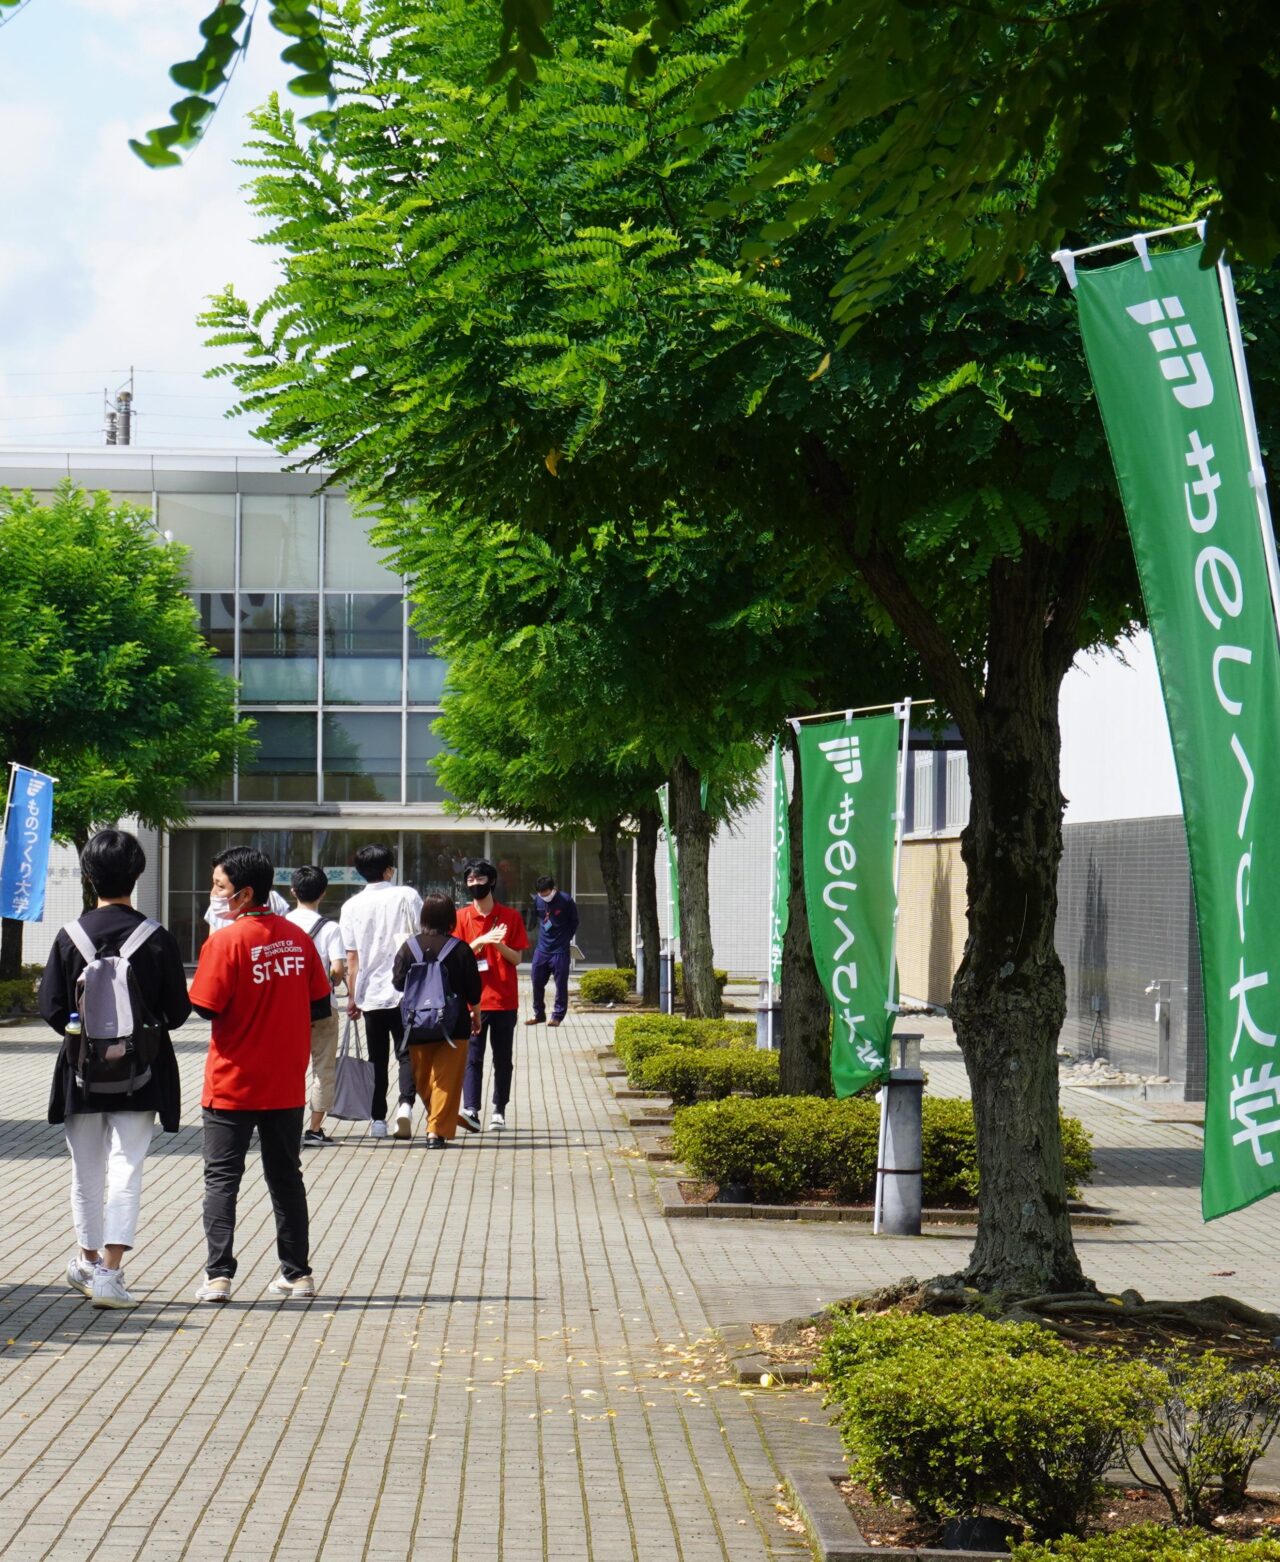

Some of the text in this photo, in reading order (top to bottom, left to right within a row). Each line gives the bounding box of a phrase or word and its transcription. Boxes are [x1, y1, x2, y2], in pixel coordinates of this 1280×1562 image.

[11, 798, 40, 915] ものつくり大学
[252, 956, 305, 984] STAFF
